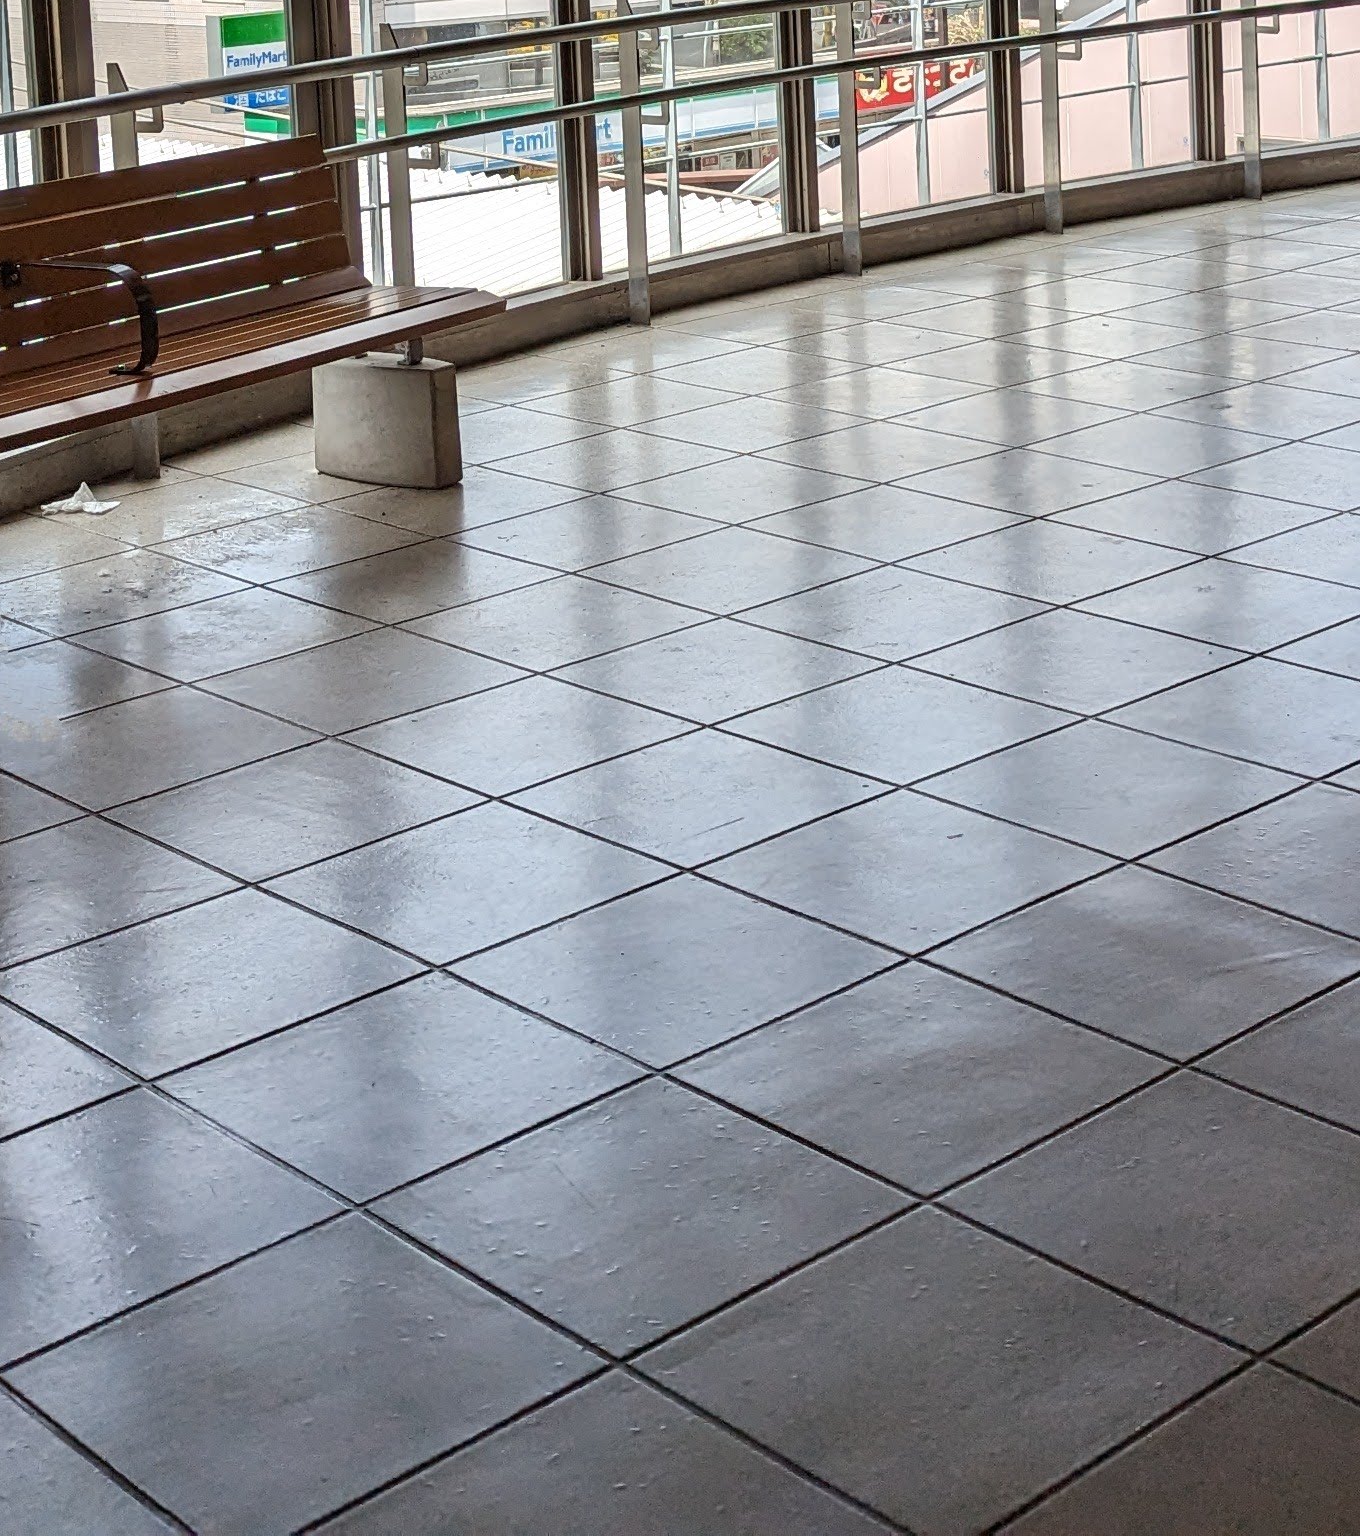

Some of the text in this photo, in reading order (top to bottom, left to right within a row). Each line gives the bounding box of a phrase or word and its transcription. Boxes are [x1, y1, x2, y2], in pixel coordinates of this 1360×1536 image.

[226, 50, 288, 69] FamilyMart
[255, 87, 287, 104] たばこ
